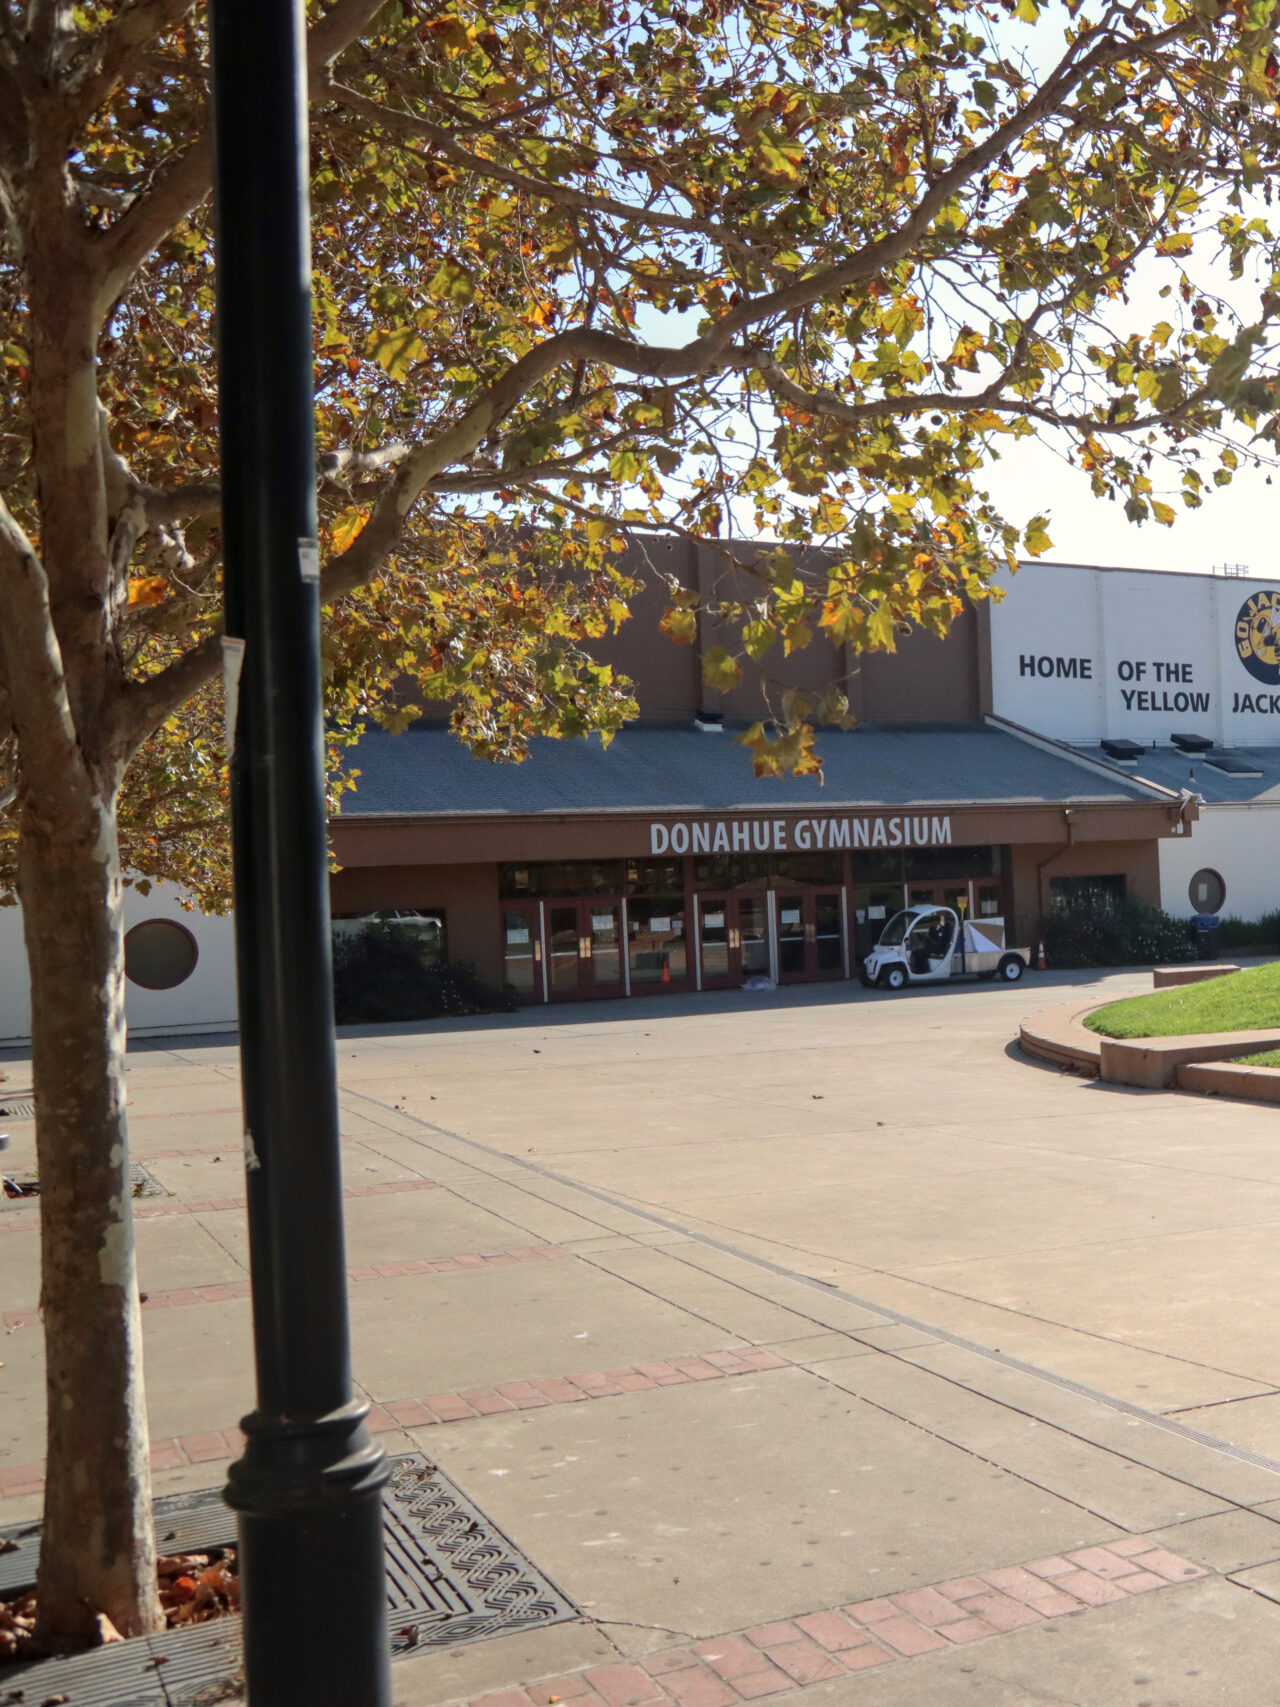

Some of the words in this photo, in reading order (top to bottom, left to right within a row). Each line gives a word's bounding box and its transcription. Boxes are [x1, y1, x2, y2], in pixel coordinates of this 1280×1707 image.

[1237, 621, 1252, 658] GO
[1019, 655, 1092, 679] HOME
[1117, 660, 1147, 681] OF
[1152, 662, 1194, 683] THE
[1121, 689, 1211, 713] YELLOW
[650, 820, 787, 855] DONAHUE
[794, 816, 952, 849] GYMNASIUM
